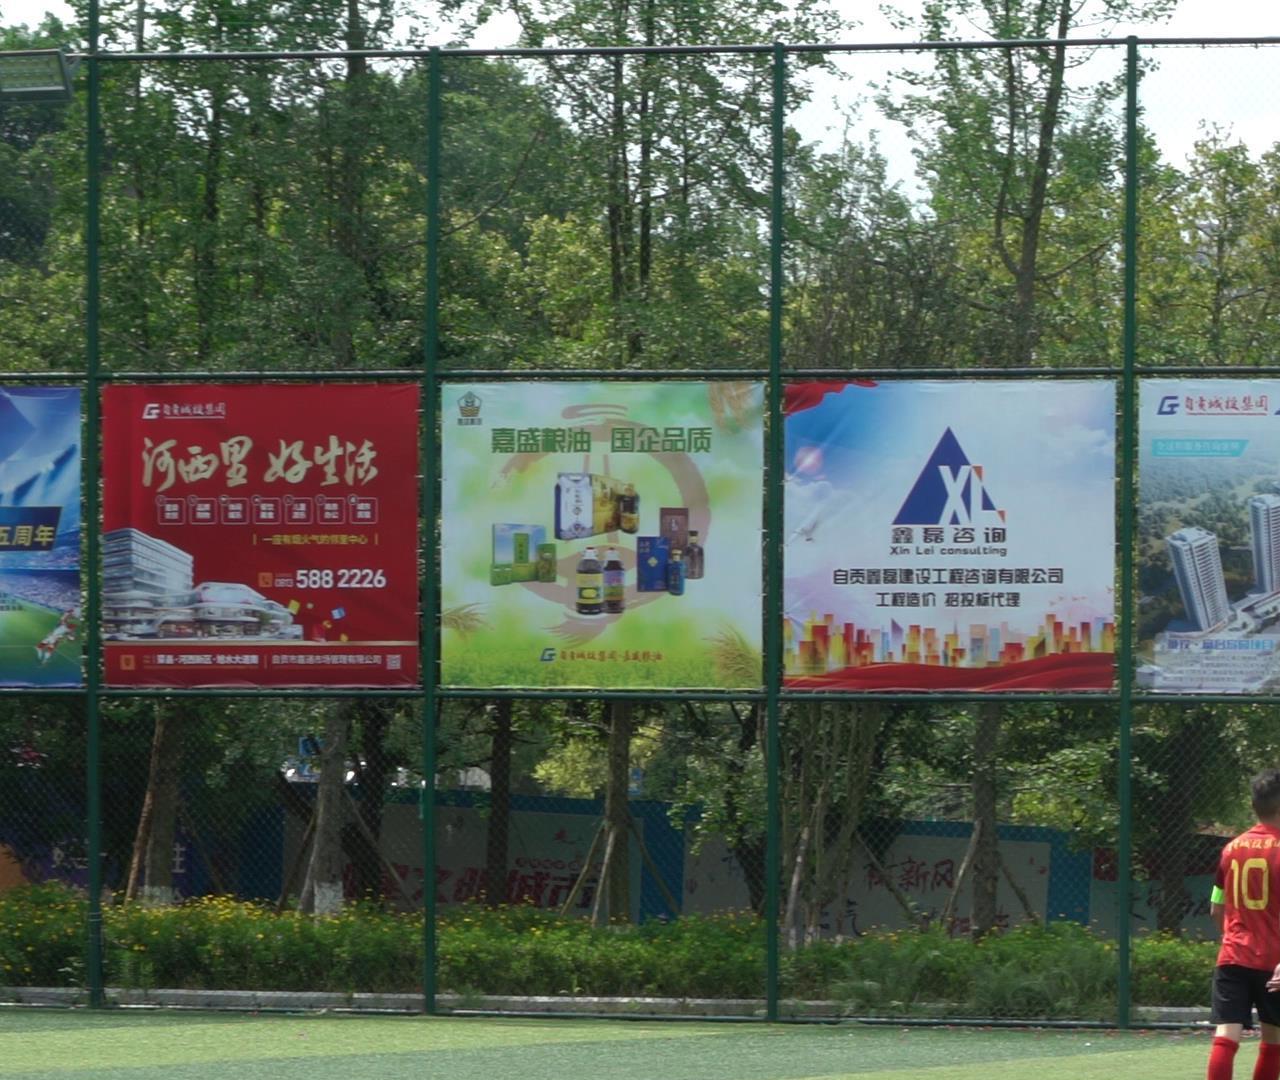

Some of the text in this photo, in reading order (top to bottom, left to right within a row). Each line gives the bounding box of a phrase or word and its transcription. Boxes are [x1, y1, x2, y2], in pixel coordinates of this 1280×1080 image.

[491, 427, 713, 454] 嘉盛粮油 国企品质
[142, 435, 379, 492] 河西里 好生活
[891, 527, 1006, 544] 鑫磊咨询
[889, 546, 1008, 557] Xin Lei consulting
[296, 569, 333, 588] 588
[337, 569, 387, 588] 2226
[833, 568, 1064, 585] 自贡鑫磊建设工程咨询有限公司
[876, 592, 1021, 607] 工程造价 招投标代理
[1231, 858, 1270, 910] 10
